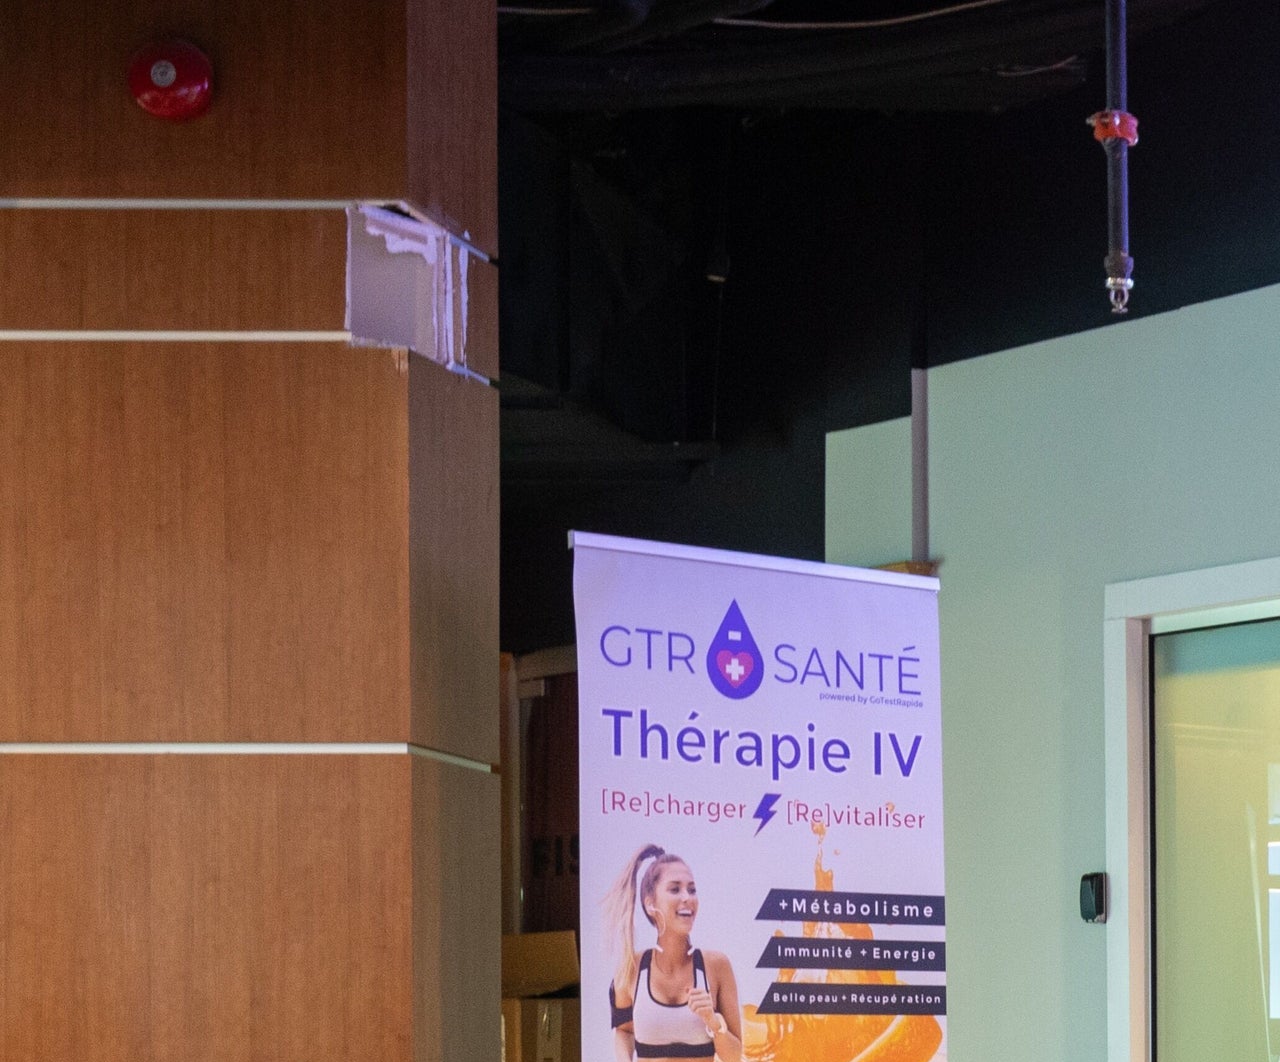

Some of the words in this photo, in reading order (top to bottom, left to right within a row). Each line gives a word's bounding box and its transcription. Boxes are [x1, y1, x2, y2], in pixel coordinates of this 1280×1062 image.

[600, 625, 695, 674] GTR
[774, 644, 922, 695] SANTÉ
[819, 691, 856, 704] powered
[857, 693, 868, 705] by
[602, 709, 851, 780] Thérapie
[873, 732, 922, 777] IV
[601, 789, 747, 823] [Re]charger
[787, 800, 925, 829] [Re]vitaliser
[777, 945, 852, 959] Immunité
[873, 947, 936, 962] Energie
[773, 992, 806, 1003] Belle
[809, 994, 838, 1005] peau
